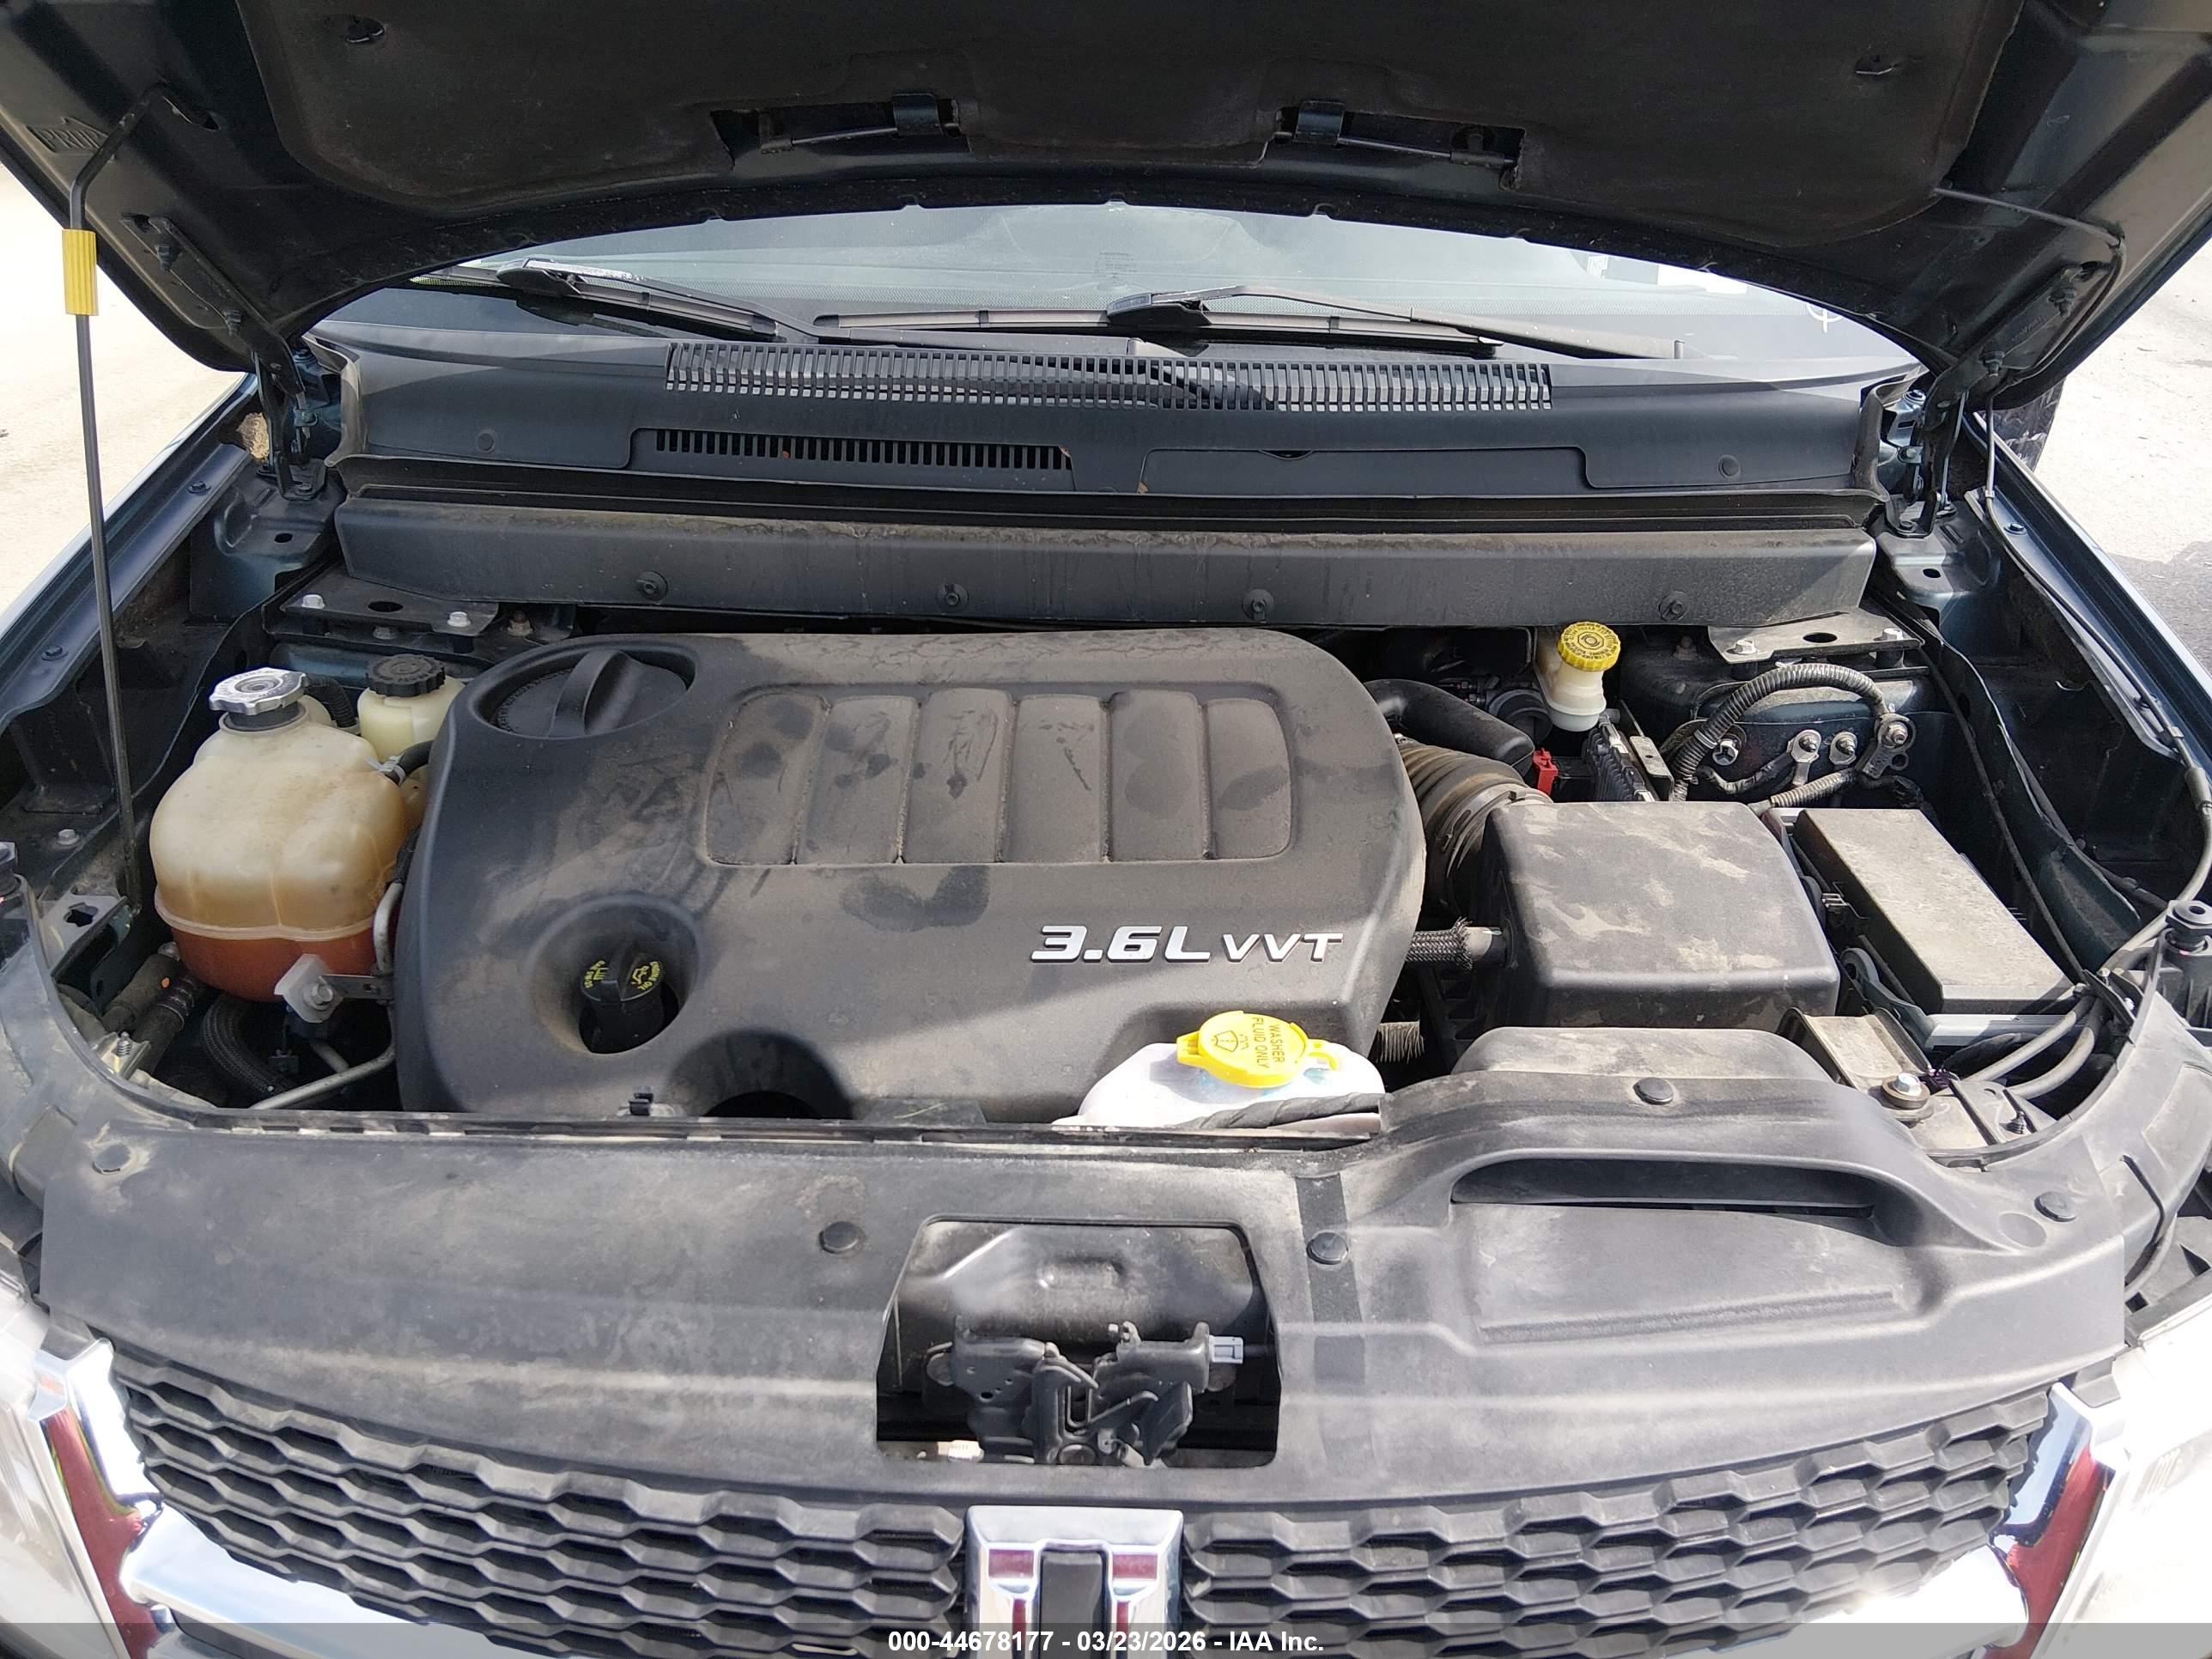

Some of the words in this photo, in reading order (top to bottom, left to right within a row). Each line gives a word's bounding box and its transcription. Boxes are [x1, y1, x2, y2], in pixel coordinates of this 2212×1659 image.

[1031, 925, 1211, 963] 3.6L
[1222, 933, 1344, 962] VVT
[637, 981, 653, 990] OIL
[1251, 1017, 1266, 1043] FLUID
[1255, 1045, 1269, 1068] ONLY
[1269, 1024, 1285, 1063] WASHER
